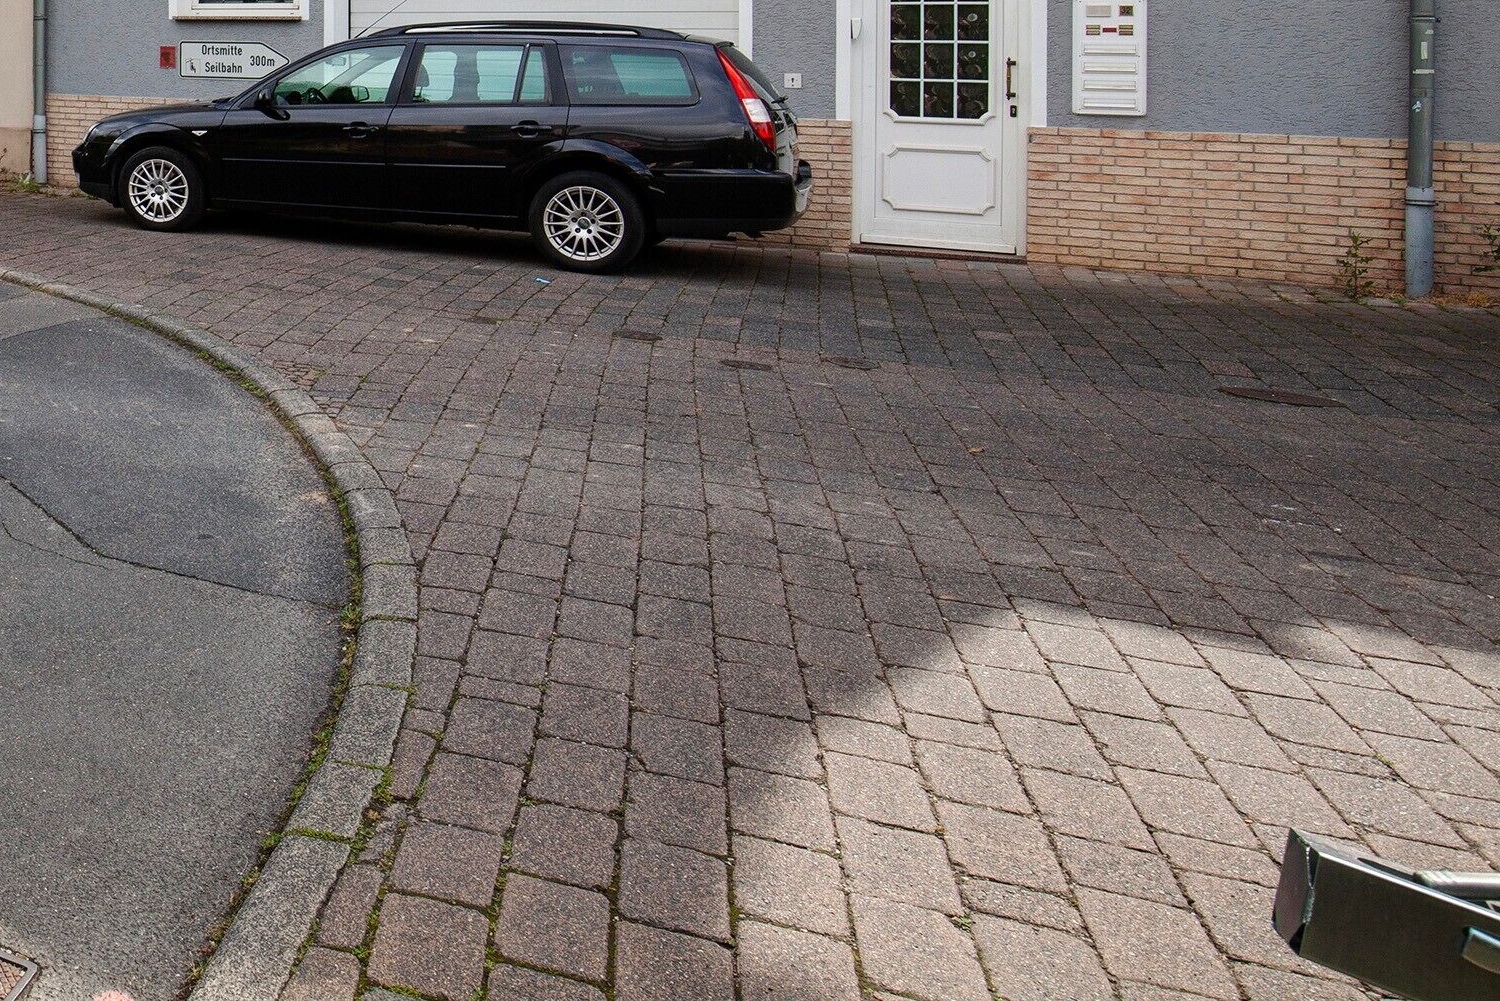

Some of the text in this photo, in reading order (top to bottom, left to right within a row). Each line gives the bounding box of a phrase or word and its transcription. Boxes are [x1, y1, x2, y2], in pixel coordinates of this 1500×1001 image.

[201, 44, 243, 56] Ortsmitte
[249, 55, 275, 67] 300m
[204, 61, 243, 74] Seilbahn
